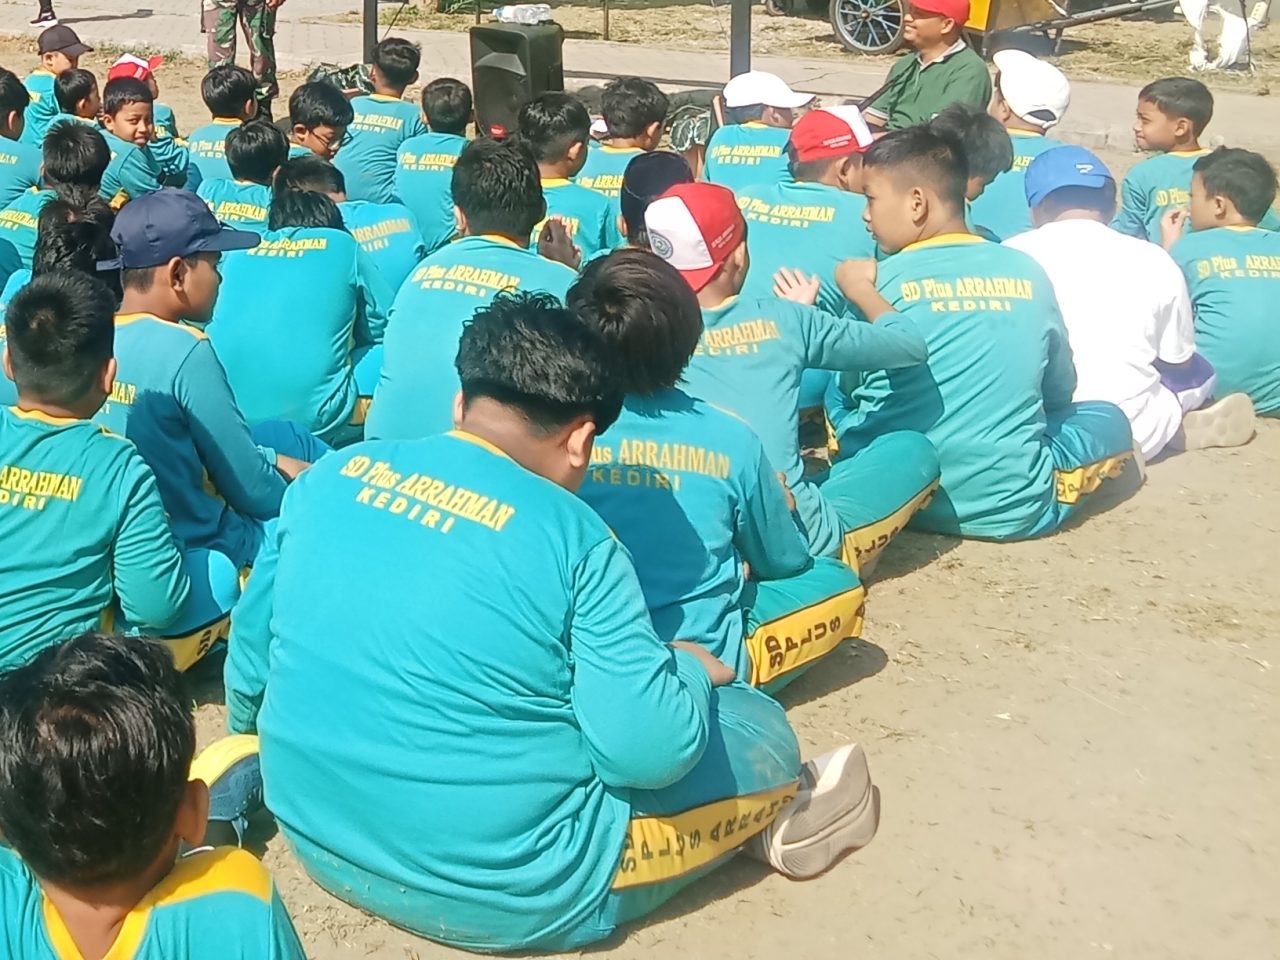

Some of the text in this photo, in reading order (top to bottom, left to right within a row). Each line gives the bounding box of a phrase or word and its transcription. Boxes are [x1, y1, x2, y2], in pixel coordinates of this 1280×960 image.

[717, 156, 761, 165] KEDIRI
[747, 211, 809, 228] KEDIRI
[770, 204, 835, 222] ARRAHMAN
[1211, 256, 1237, 272] Plus
[445, 264, 521, 293] ARRAHMAN
[420, 280, 487, 298] KEDIRI
[901, 276, 1033, 302] SD Plus ARRAHMAN
[931, 300, 1012, 313] KEDIRI
[694, 344, 760, 355] EDIRI
[619, 439, 732, 480] ARRAHMAN
[592, 469, 682, 492] KEDIRI
[340, 455, 516, 532] SD Plus ARRAHMAN
[355, 486, 455, 535] KEDIRI
[765, 616, 841, 668] SD PLUS
